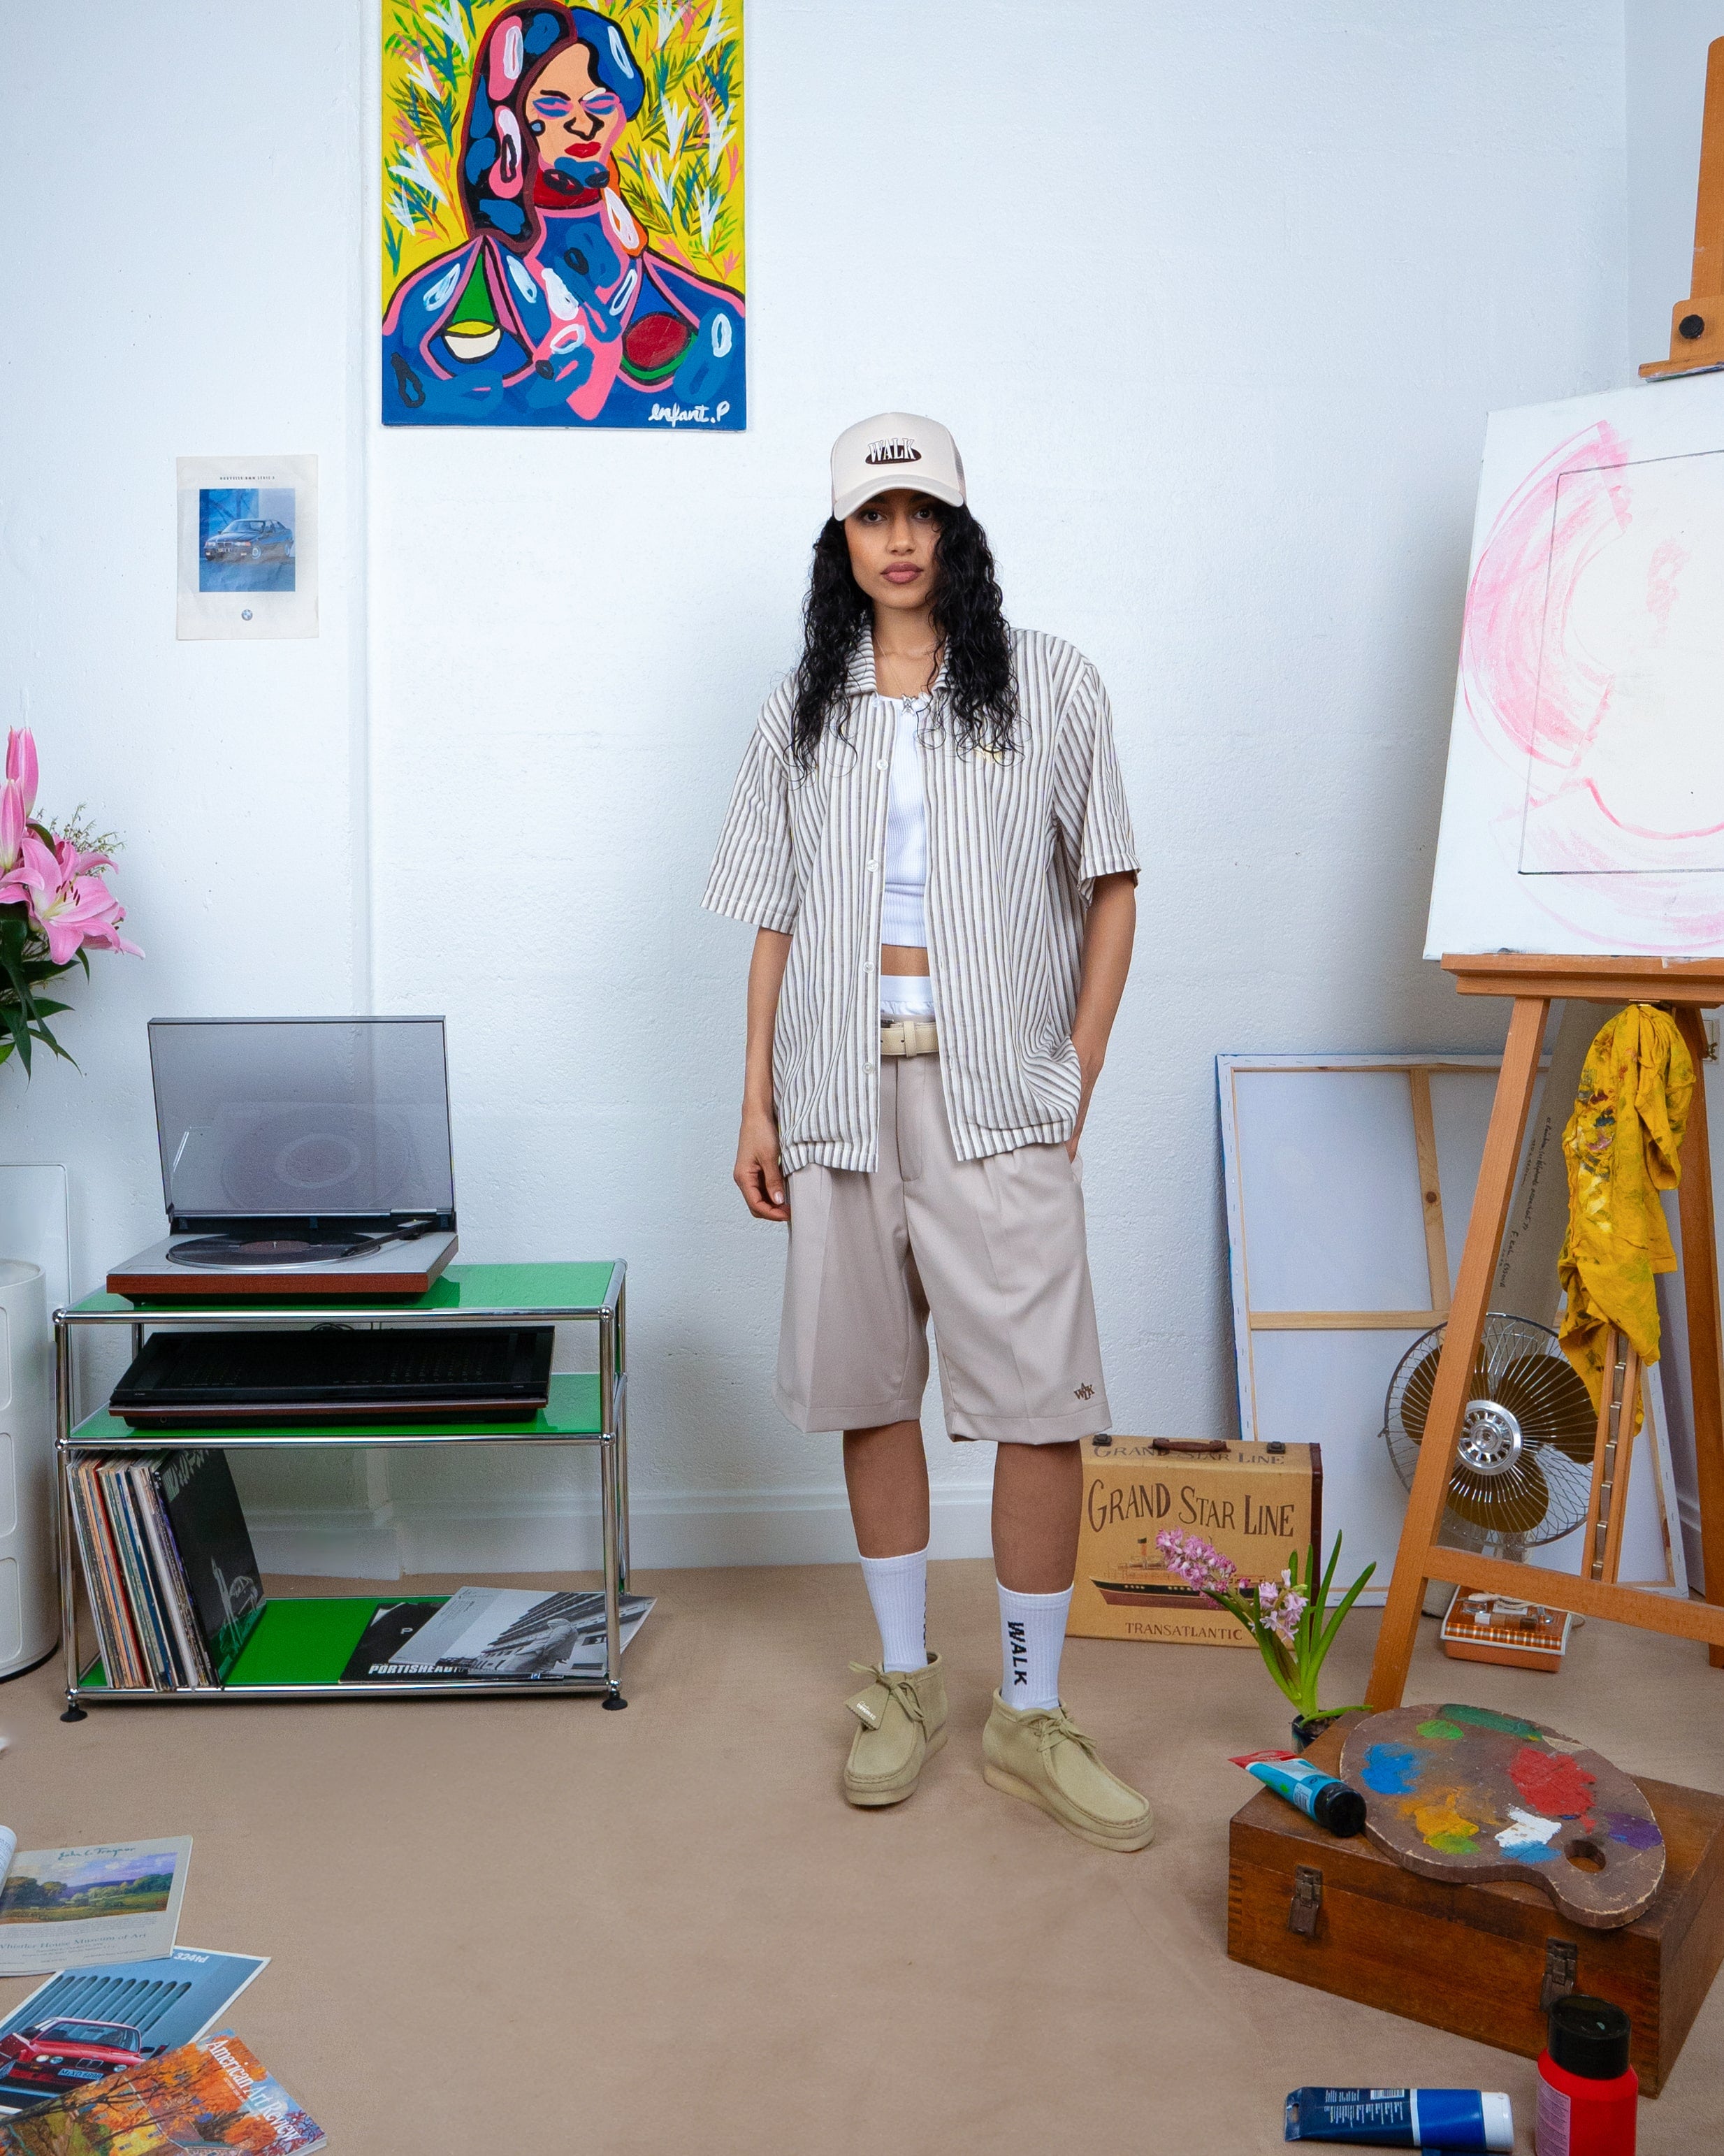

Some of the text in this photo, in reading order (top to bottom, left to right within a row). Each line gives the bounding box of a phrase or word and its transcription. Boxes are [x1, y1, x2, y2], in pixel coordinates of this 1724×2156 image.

[868, 437, 915, 463] WALK
[1238, 1452, 1285, 1465] LINE
[1087, 1478, 1294, 1538] GRAND STAR LINE
[1125, 1622, 1243, 1641] TRANSATLANTIC
[1008, 1621, 1028, 1686] WALK
[74, 1935, 115, 1944] Museum
[173, 1952, 210, 1964] 324td
[205, 2039, 254, 2088] American
[243, 2085, 273, 2107] Art
[259, 2099, 303, 2141] Review
